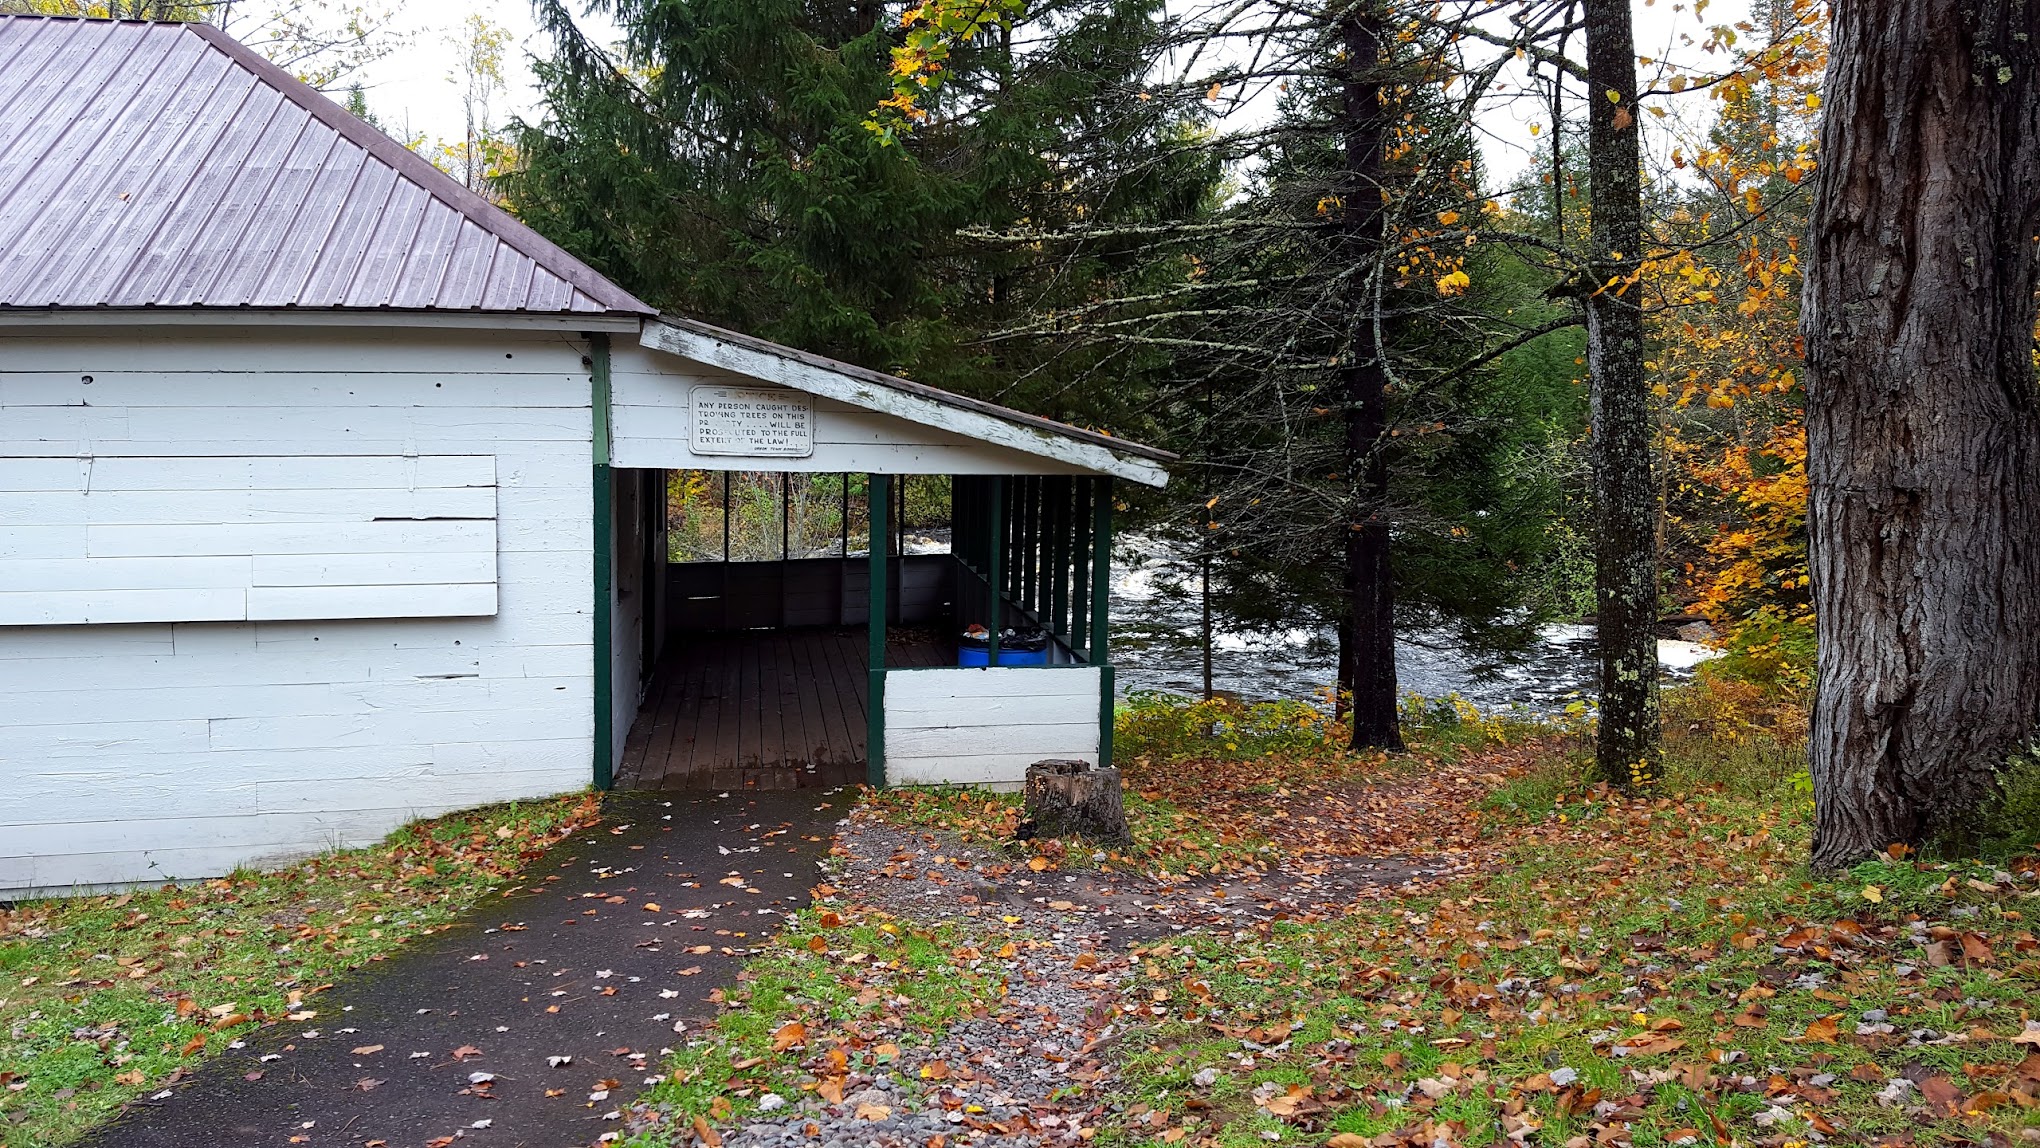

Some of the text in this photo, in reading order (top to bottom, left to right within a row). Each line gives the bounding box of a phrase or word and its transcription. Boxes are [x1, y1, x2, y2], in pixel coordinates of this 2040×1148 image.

[718, 402, 750, 410] PERSON
[756, 403, 788, 411] CAUGHT
[740, 411, 767, 419] TREES
[699, 419, 806, 429] PRTY WILL BE
[699, 428, 756, 436] PROSUTED
